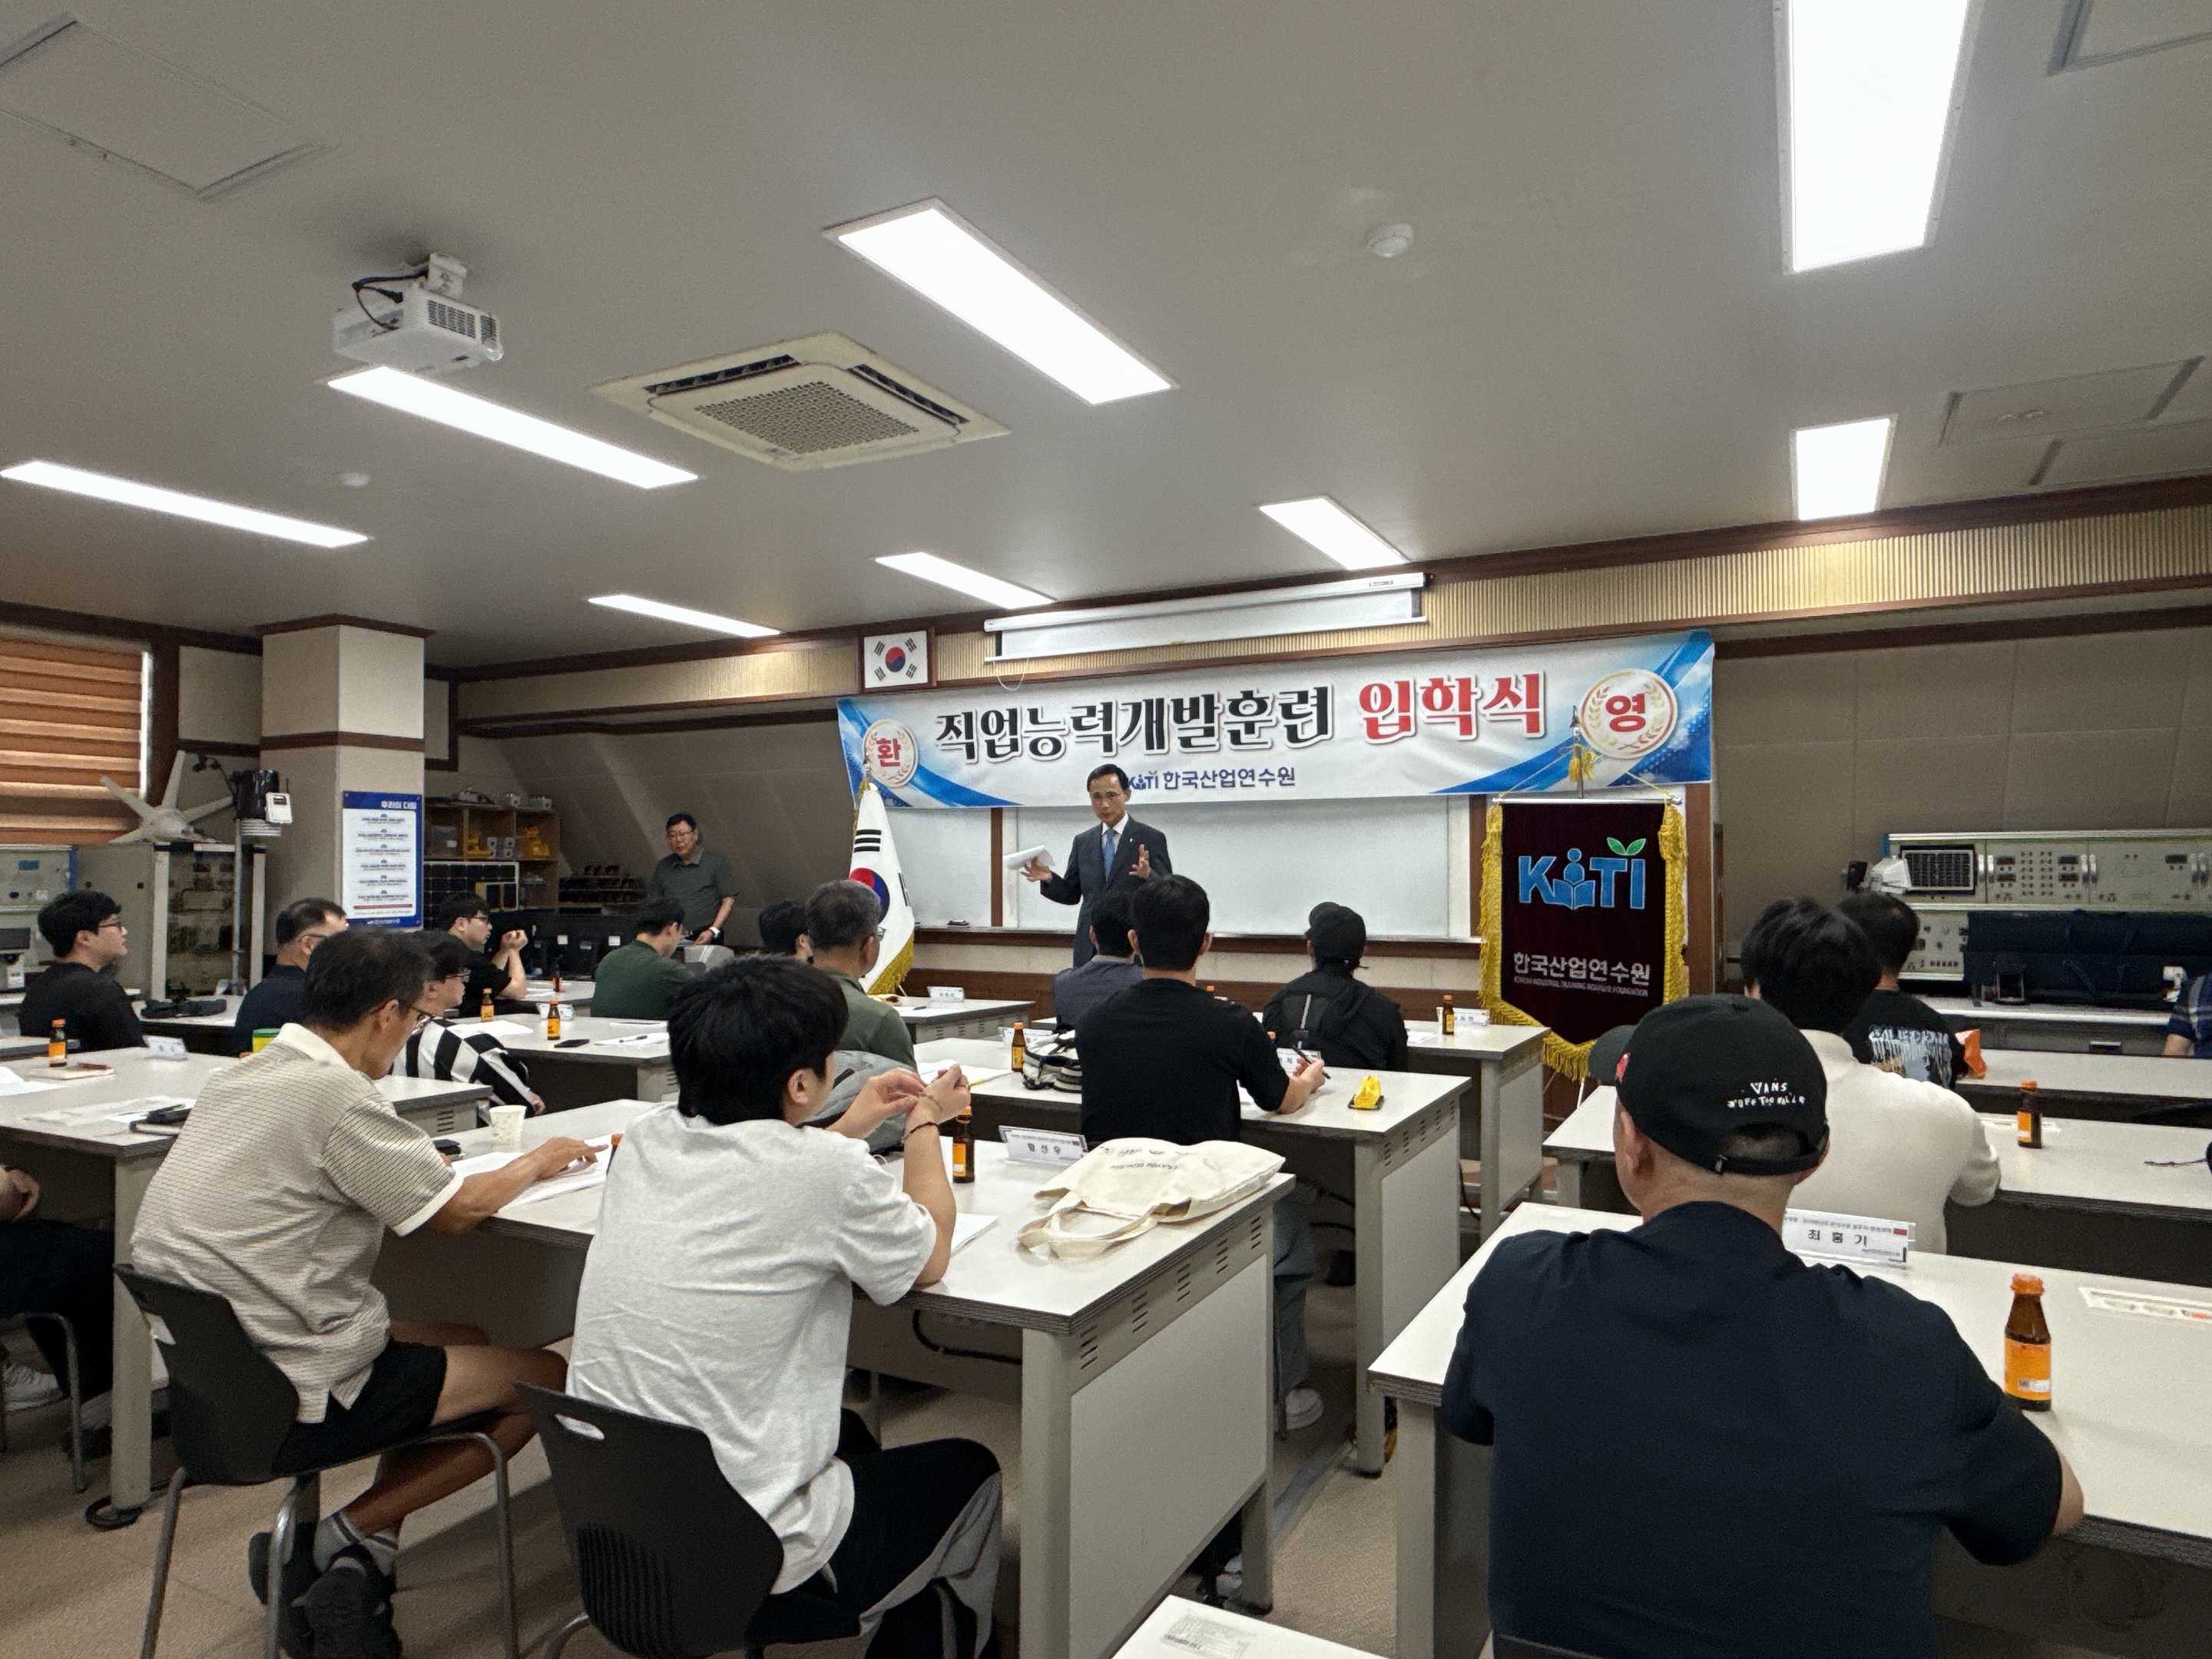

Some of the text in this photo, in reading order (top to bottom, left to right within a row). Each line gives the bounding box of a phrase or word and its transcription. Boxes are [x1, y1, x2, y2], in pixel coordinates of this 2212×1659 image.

[936, 673, 1540, 759] 직업능력개발훈련 입학식
[1605, 692, 1646, 733] 영
[876, 737, 902, 767] 환
[1163, 767, 1296, 790] 한국산업연수원
[1513, 951, 1651, 986] 한국산업연수원
[1750, 1081, 1787, 1094] VANS
